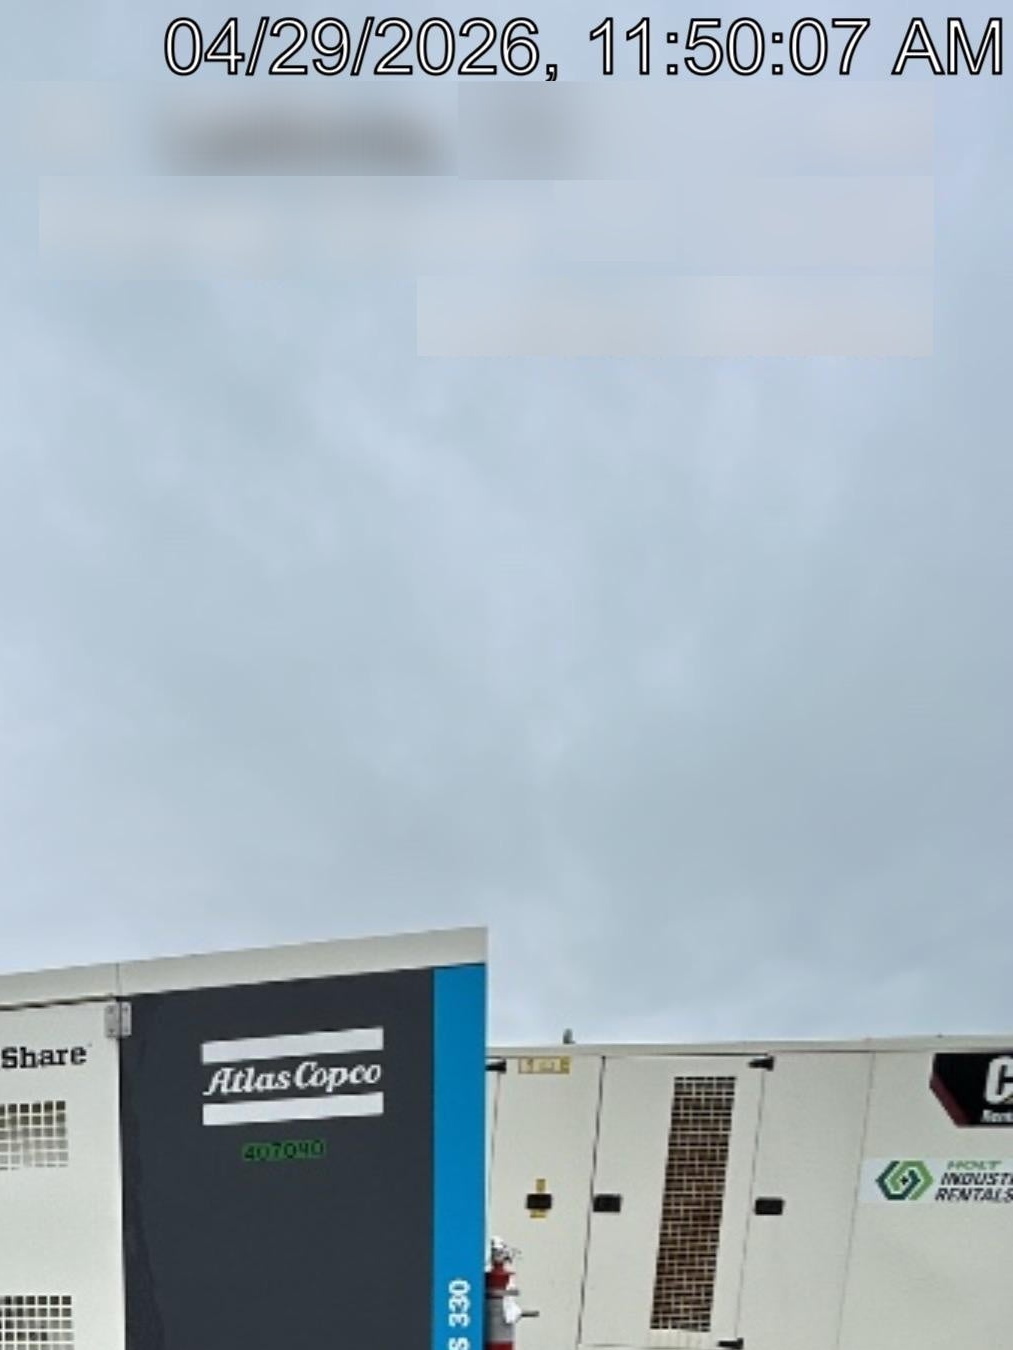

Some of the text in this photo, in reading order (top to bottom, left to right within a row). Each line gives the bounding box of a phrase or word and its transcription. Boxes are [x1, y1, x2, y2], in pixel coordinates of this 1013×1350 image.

[202, 1061, 382, 1096] Atlas Copco
[448, 1279, 470, 1328] 330
